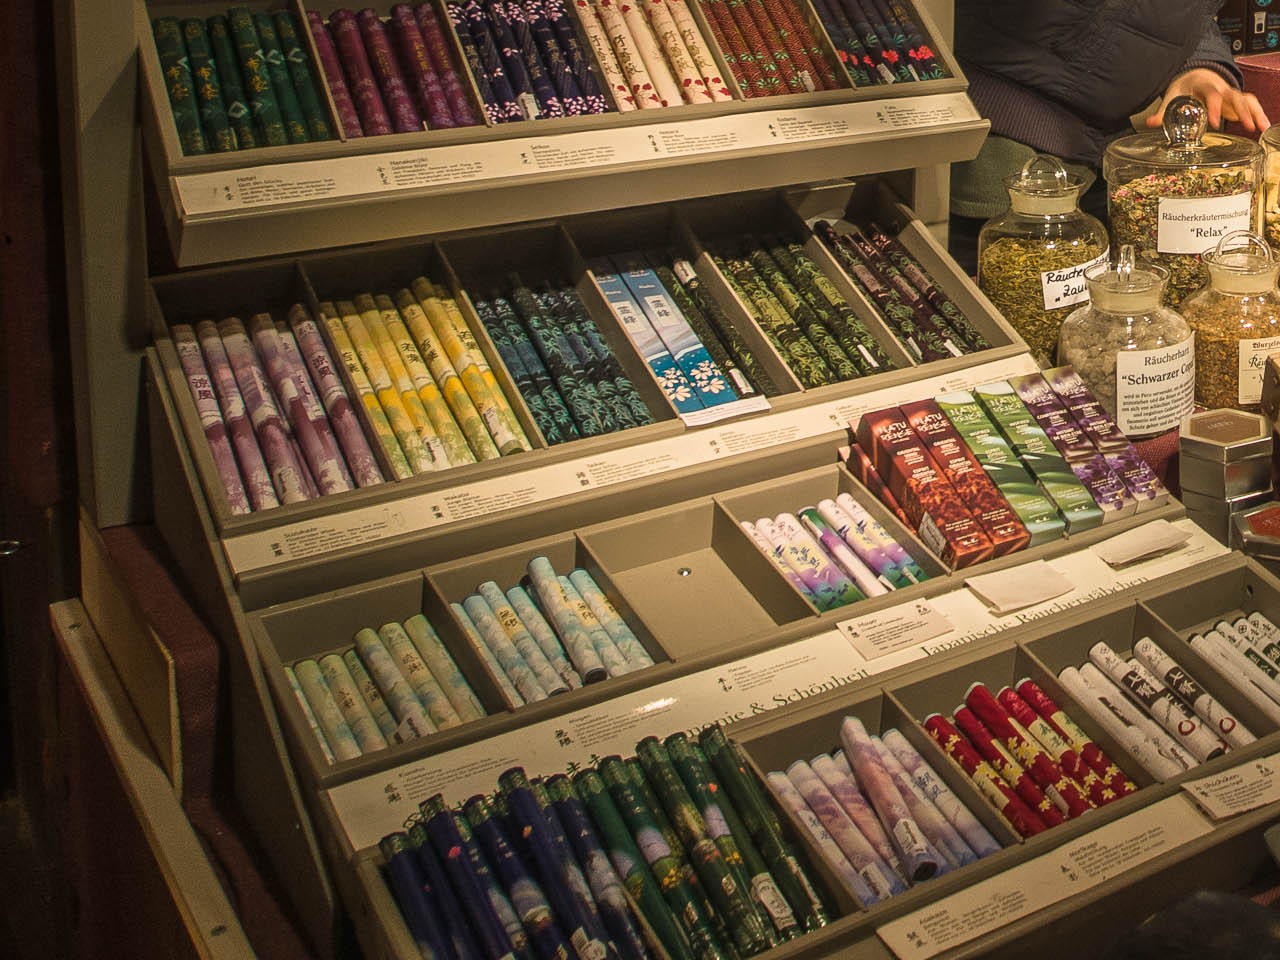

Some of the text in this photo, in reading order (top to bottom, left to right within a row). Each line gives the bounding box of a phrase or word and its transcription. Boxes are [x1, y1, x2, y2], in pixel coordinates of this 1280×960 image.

[1161, 207, 1249, 223] Räucherkräutermischung
[1144, 346, 1190, 367] Räucherharz
[876, 421, 907, 434] NATU
[914, 413, 943, 425] NATU
[1015, 575, 1151, 627] Räucherstäbchen
[771, 667, 870, 707] Schönheit
